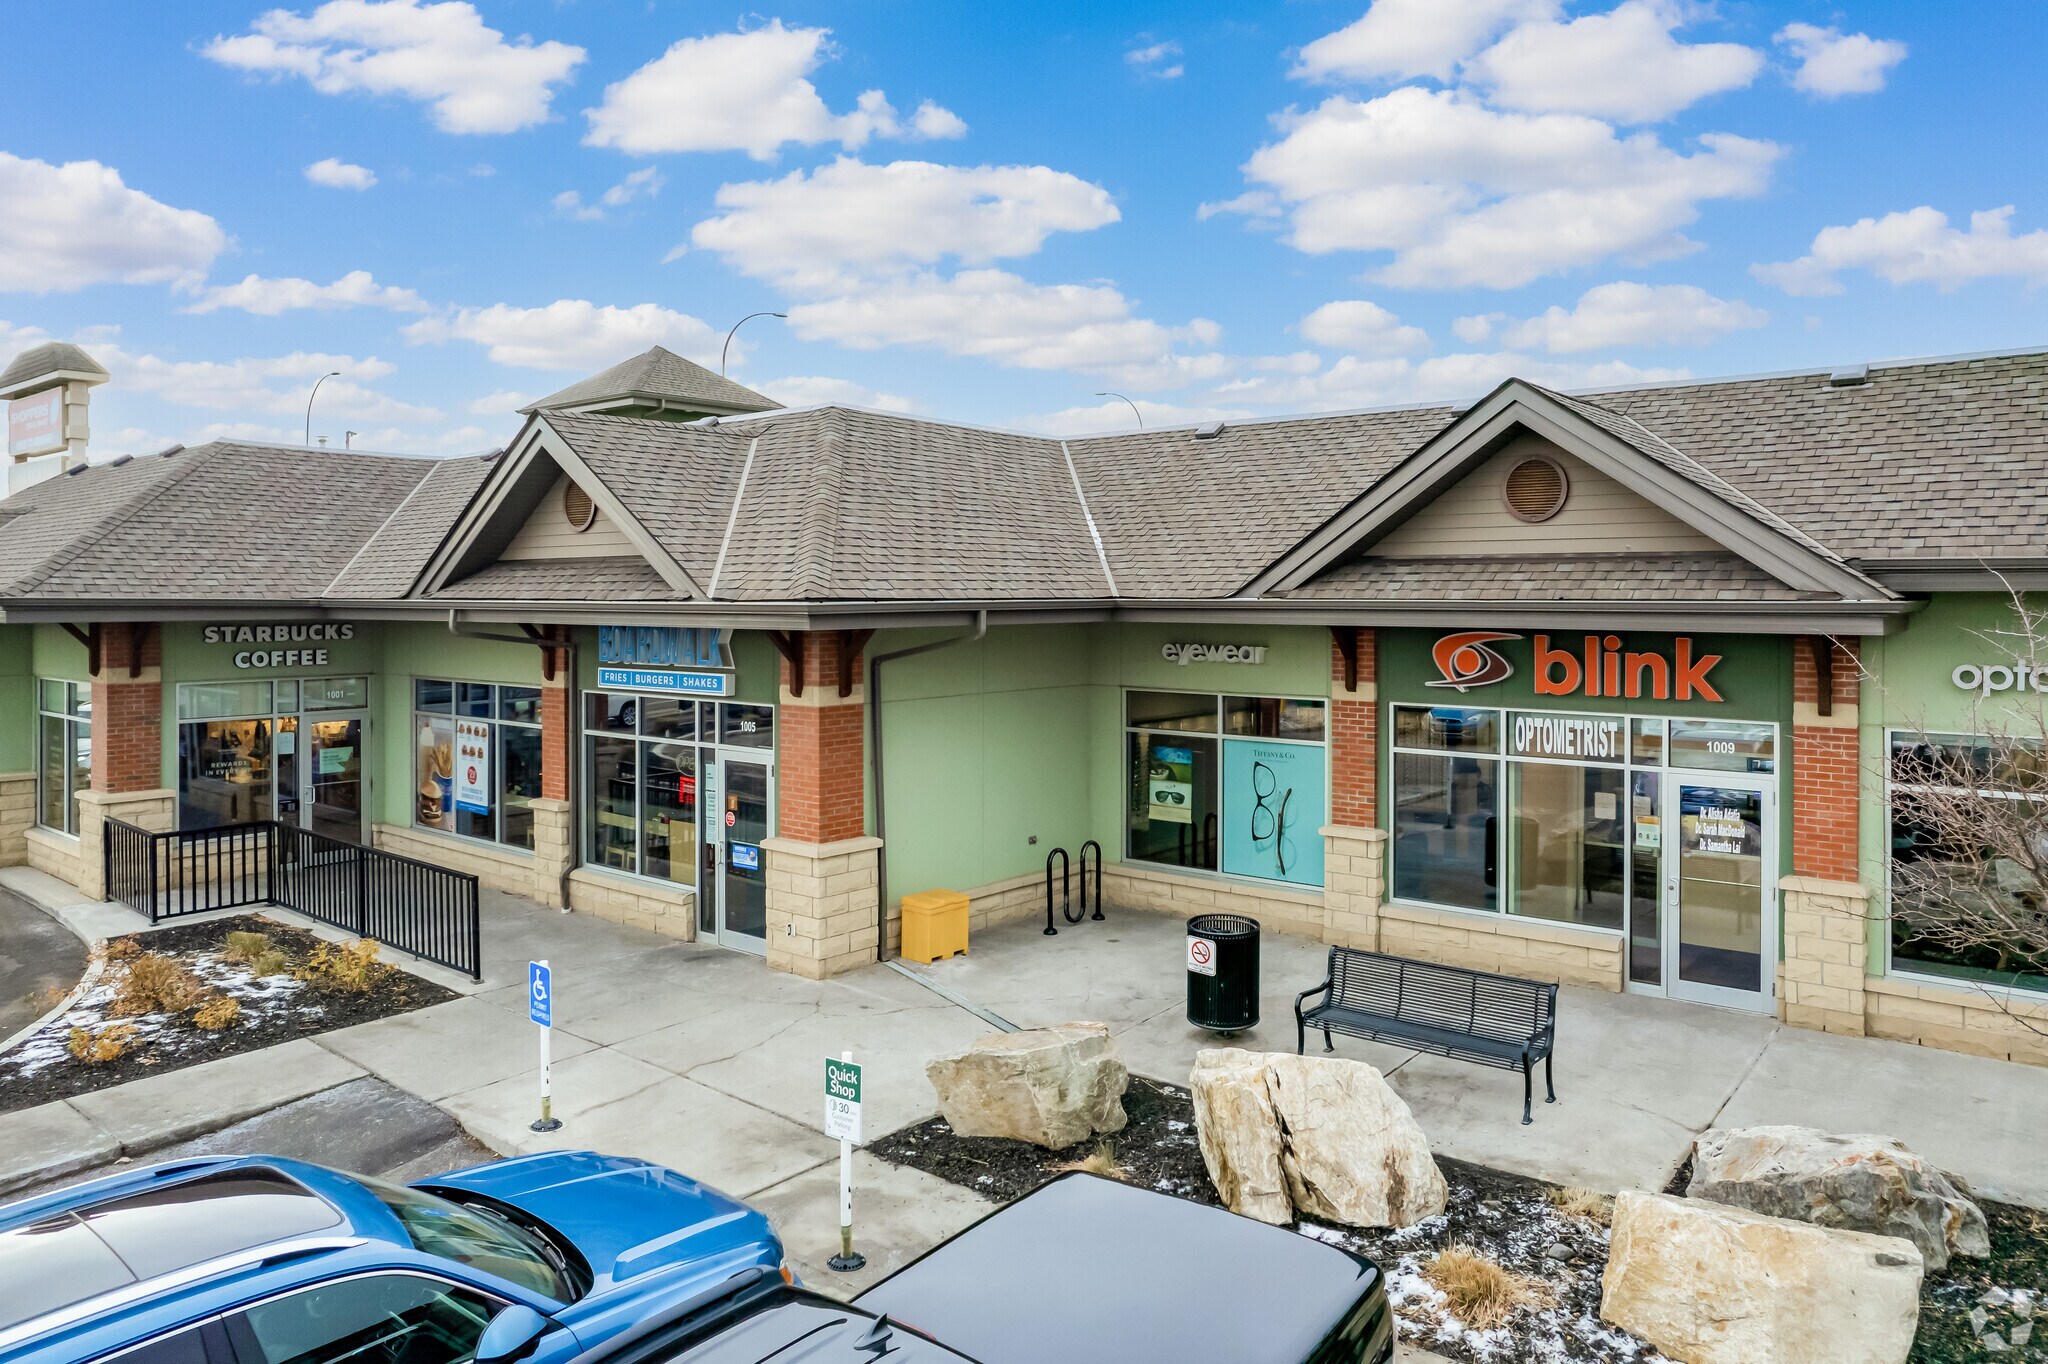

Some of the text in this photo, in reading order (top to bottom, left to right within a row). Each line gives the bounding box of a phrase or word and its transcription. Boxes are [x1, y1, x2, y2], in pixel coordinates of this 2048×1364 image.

[12, 404, 49, 424] SHOPPERS
[204, 624, 354, 643] STARBUCKS
[235, 649, 328, 668] COFFEE
[1162, 643, 1268, 666] eyewear
[1533, 635, 1725, 703] blink
[605, 672, 718, 688] FRIES BURGERS SHAKES
[327, 689, 344, 699] 1001
[740, 721, 756, 733] 1005
[1515, 716, 1618, 758] OPTOMETRIST
[1706, 741, 1735, 755] 1009
[210, 760, 248, 769] REWARDS
[678, 755, 695, 771] OPE
[1708, 807, 1723, 820] Alisha
[1703, 822, 1717, 836] Sarah
[1718, 823, 1746, 838] MacDonald
[1708, 838, 1732, 853] Samantha
[1732, 841, 1741, 854] Lai
[828, 1065, 858, 1085] Quick
[830, 1080, 856, 1100] Shop
[839, 1102, 850, 1114] 30
